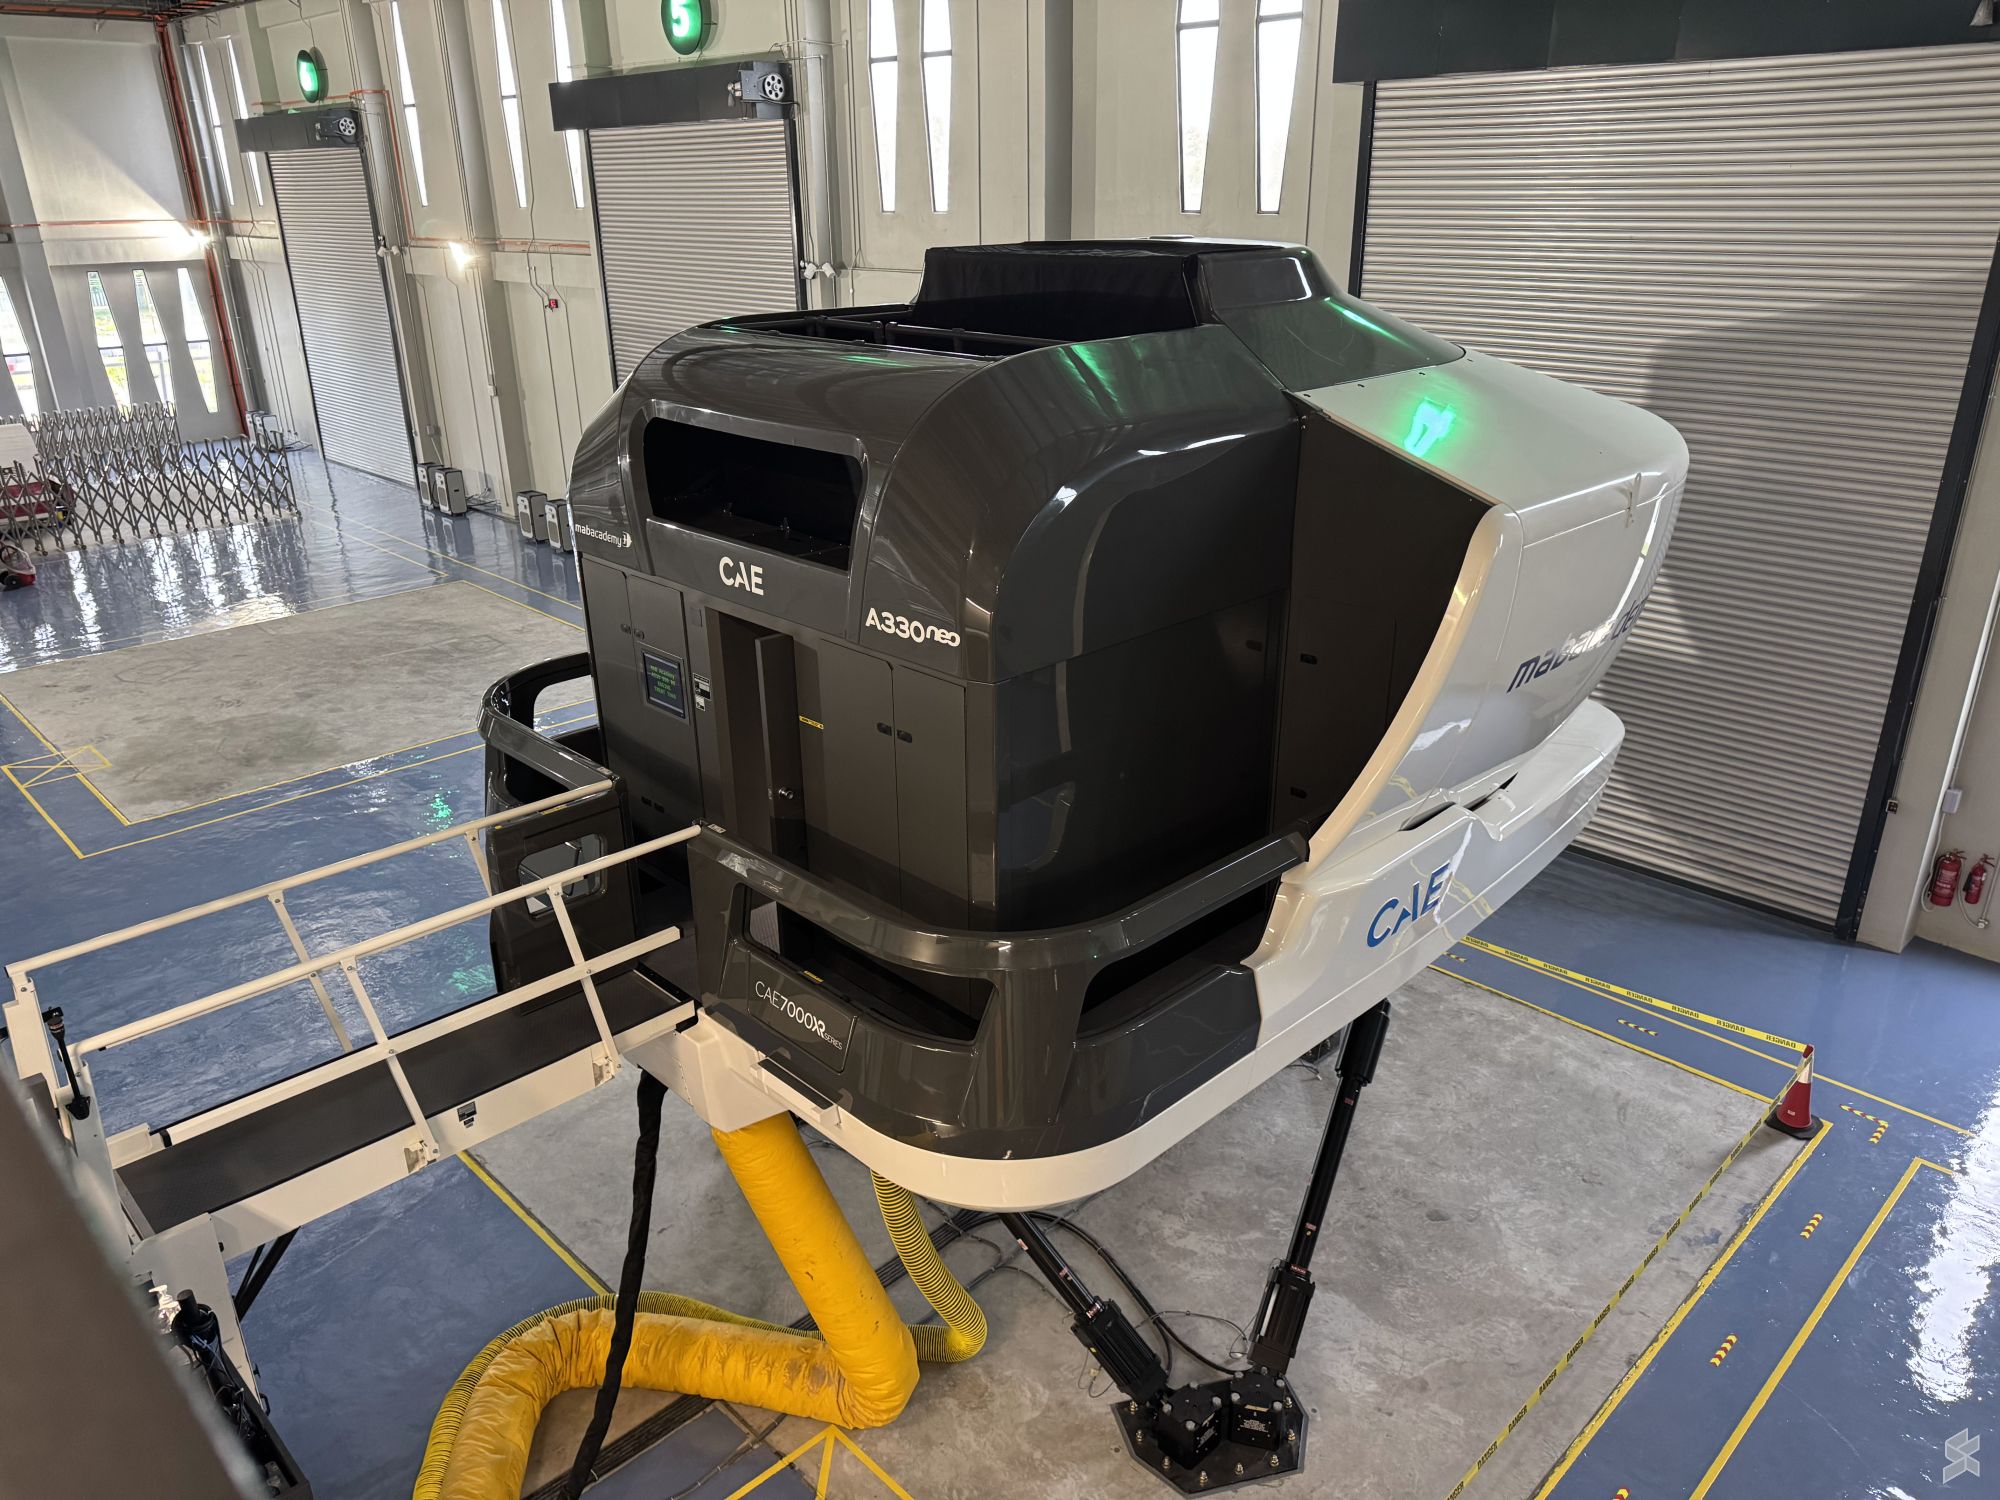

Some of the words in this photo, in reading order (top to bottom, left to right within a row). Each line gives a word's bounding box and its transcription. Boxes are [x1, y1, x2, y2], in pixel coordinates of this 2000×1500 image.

[671, 0, 690, 37] 5
[575, 523, 622, 548] mabacademy
[719, 556, 764, 596] CAE
[1367, 860, 1450, 948] CAE
[1477, 1441, 1498, 1471] DANGER
[1508, 1405, 1528, 1434] DANGER
[1539, 1369, 1557, 1395] DANGER
[1567, 1336, 1584, 1363] DANGER
